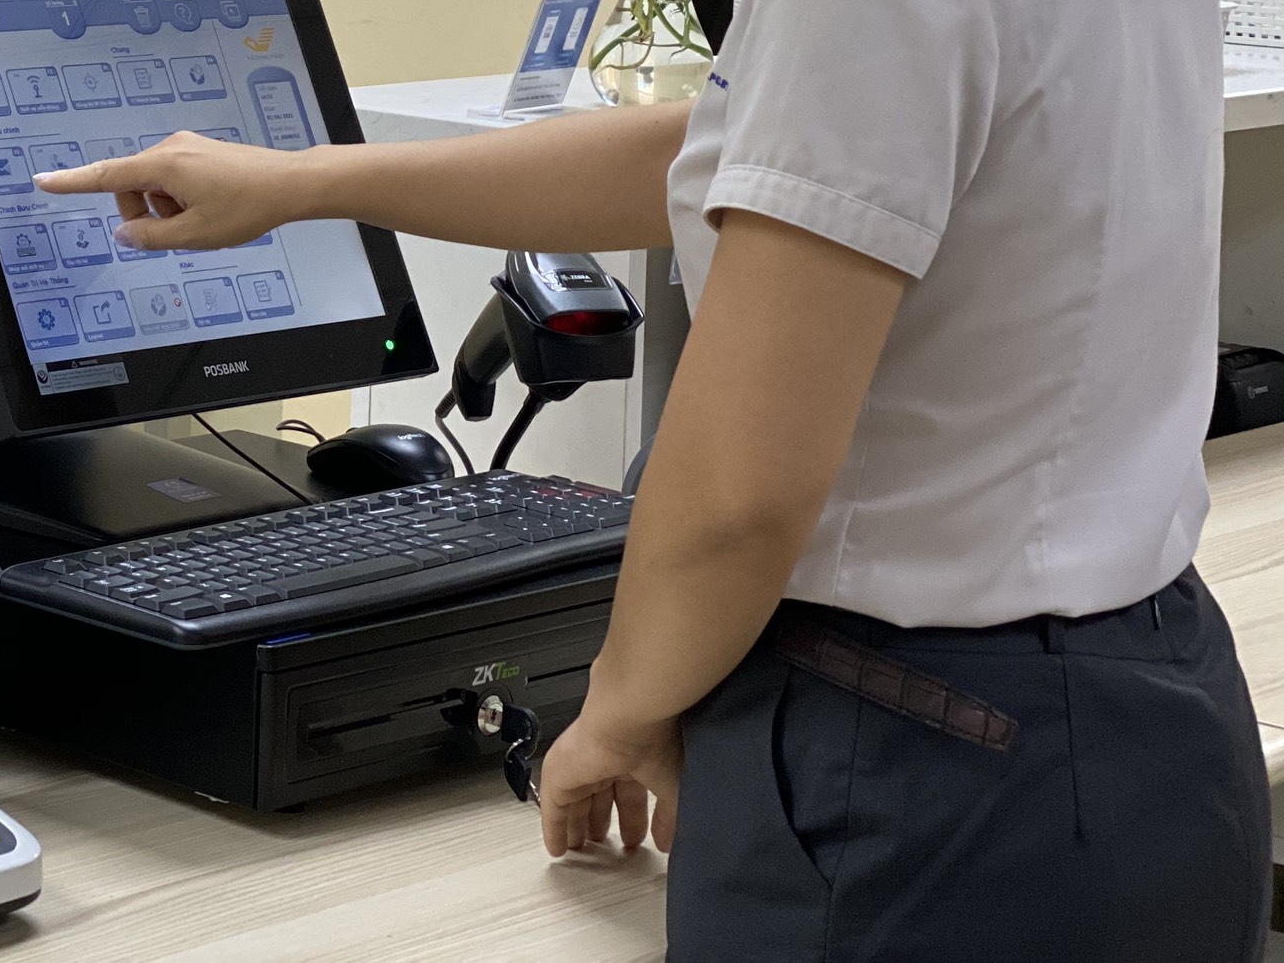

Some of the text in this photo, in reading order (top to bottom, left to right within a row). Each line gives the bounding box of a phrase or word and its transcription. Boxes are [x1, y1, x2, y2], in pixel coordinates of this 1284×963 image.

[61, 11, 70, 26] 1
[110, 46, 130, 55] Chung
[179, 261, 194, 269] Khác
[203, 360, 249, 377] POSBANK
